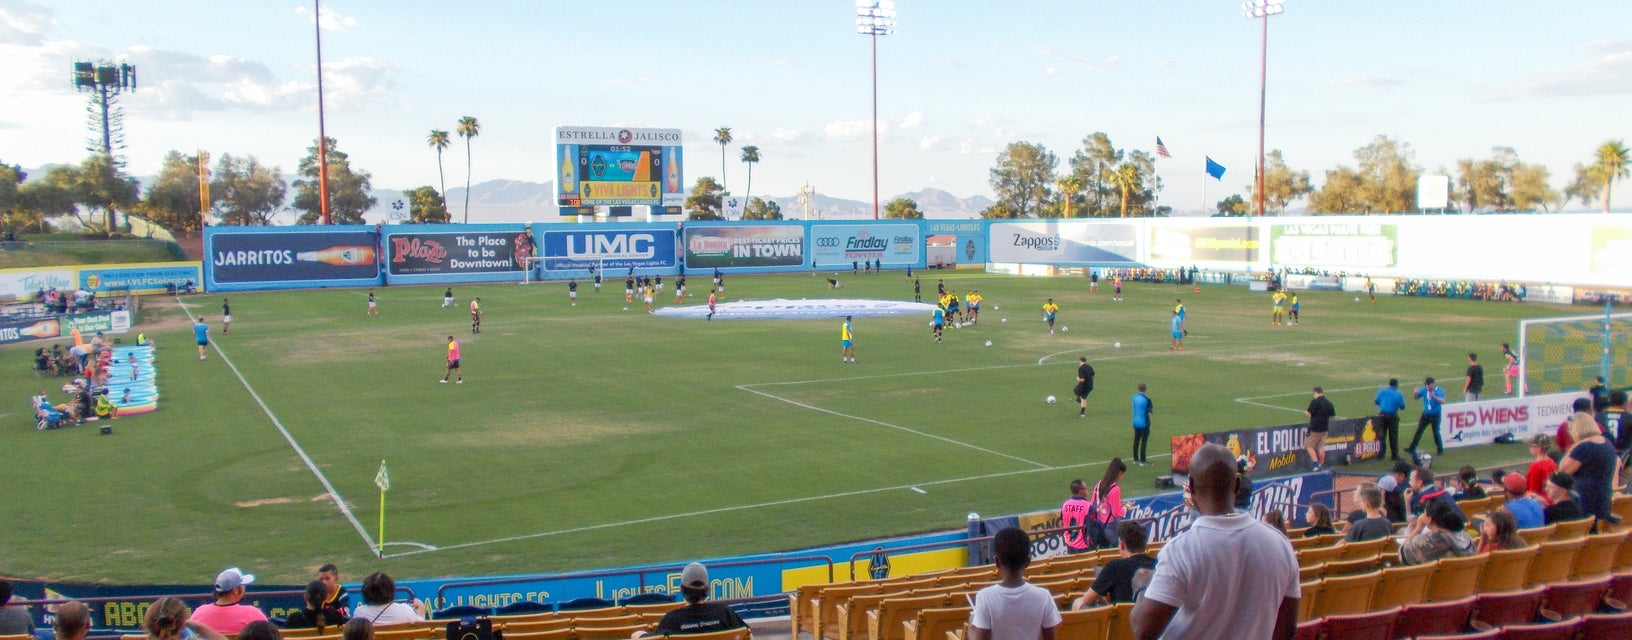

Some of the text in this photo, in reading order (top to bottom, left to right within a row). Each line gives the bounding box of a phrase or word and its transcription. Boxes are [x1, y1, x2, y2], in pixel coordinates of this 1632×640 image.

[559, 131, 679, 141] ESTRELLA JALISCO
[654, 158, 660, 166] 0
[594, 184, 648, 198] VIVA LIGHTS
[930, 224, 940, 232] LAS
[940, 224, 955, 232] VEGAS
[456, 236, 506, 246] The Place
[566, 234, 655, 260] UMC
[846, 236, 888, 251] Findlay
[894, 236, 913, 244] Findlay
[1013, 234, 1053, 249] Zappos
[392, 237, 447, 264] Plaza
[468, 246, 495, 257] to be
[734, 244, 750, 258] IN
[752, 244, 800, 257] TOWN
[214, 250, 292, 266] JARRITOS
[450, 259, 512, 269] Downtown!
[1537, 404, 1572, 417] TEDWIEN
[1447, 406, 1529, 434] TED WIENS
[1257, 432, 1270, 454] EL
[1269, 452, 1296, 471] Mobile
[1064, 504, 1084, 513] STAFF
[1128, 504, 1153, 520] The
[458, 594, 522, 608] LIGHTS
[526, 592, 550, 604] FC
